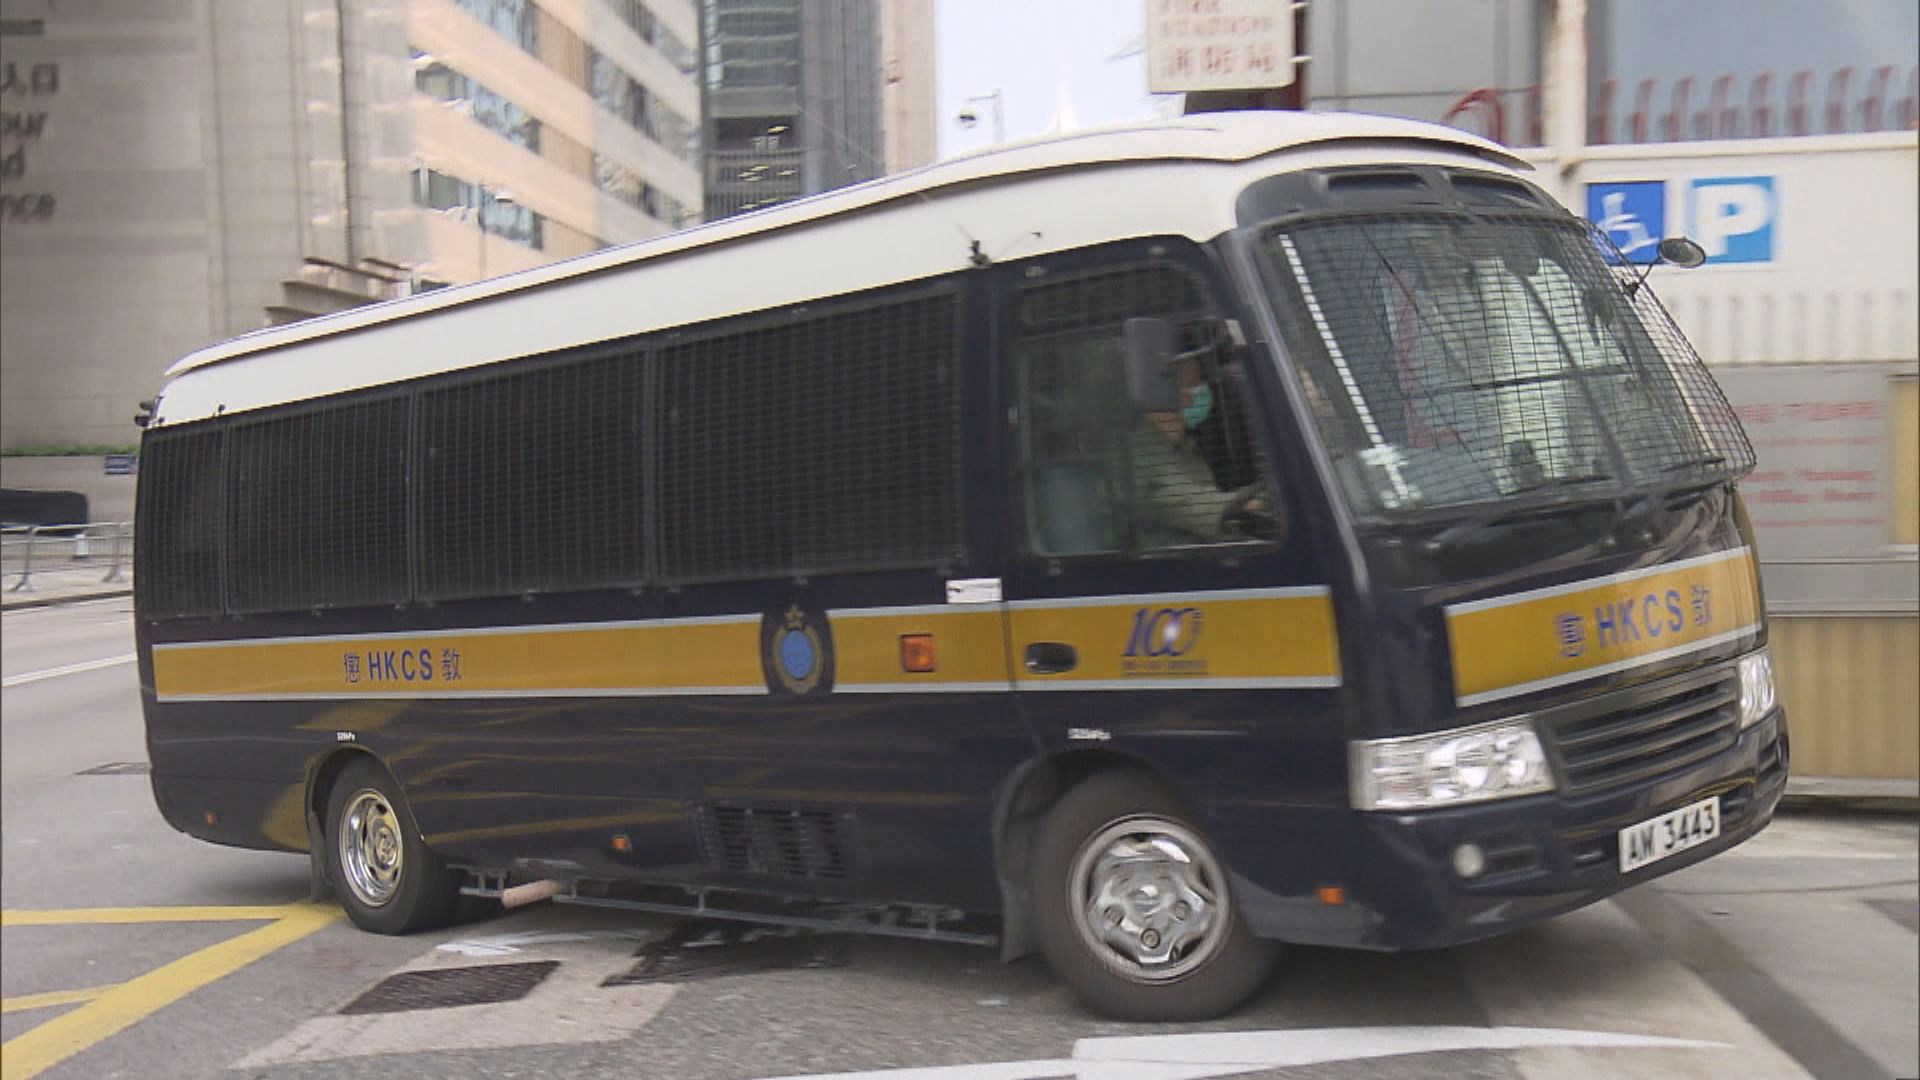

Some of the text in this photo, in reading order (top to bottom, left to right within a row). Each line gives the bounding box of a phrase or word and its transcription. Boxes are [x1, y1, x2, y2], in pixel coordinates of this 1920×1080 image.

[1694, 185, 1768, 257] P
[1594, 589, 1685, 648] HKCS
[368, 648, 433, 681] HKCS
[1664, 803, 1715, 850] 3443
